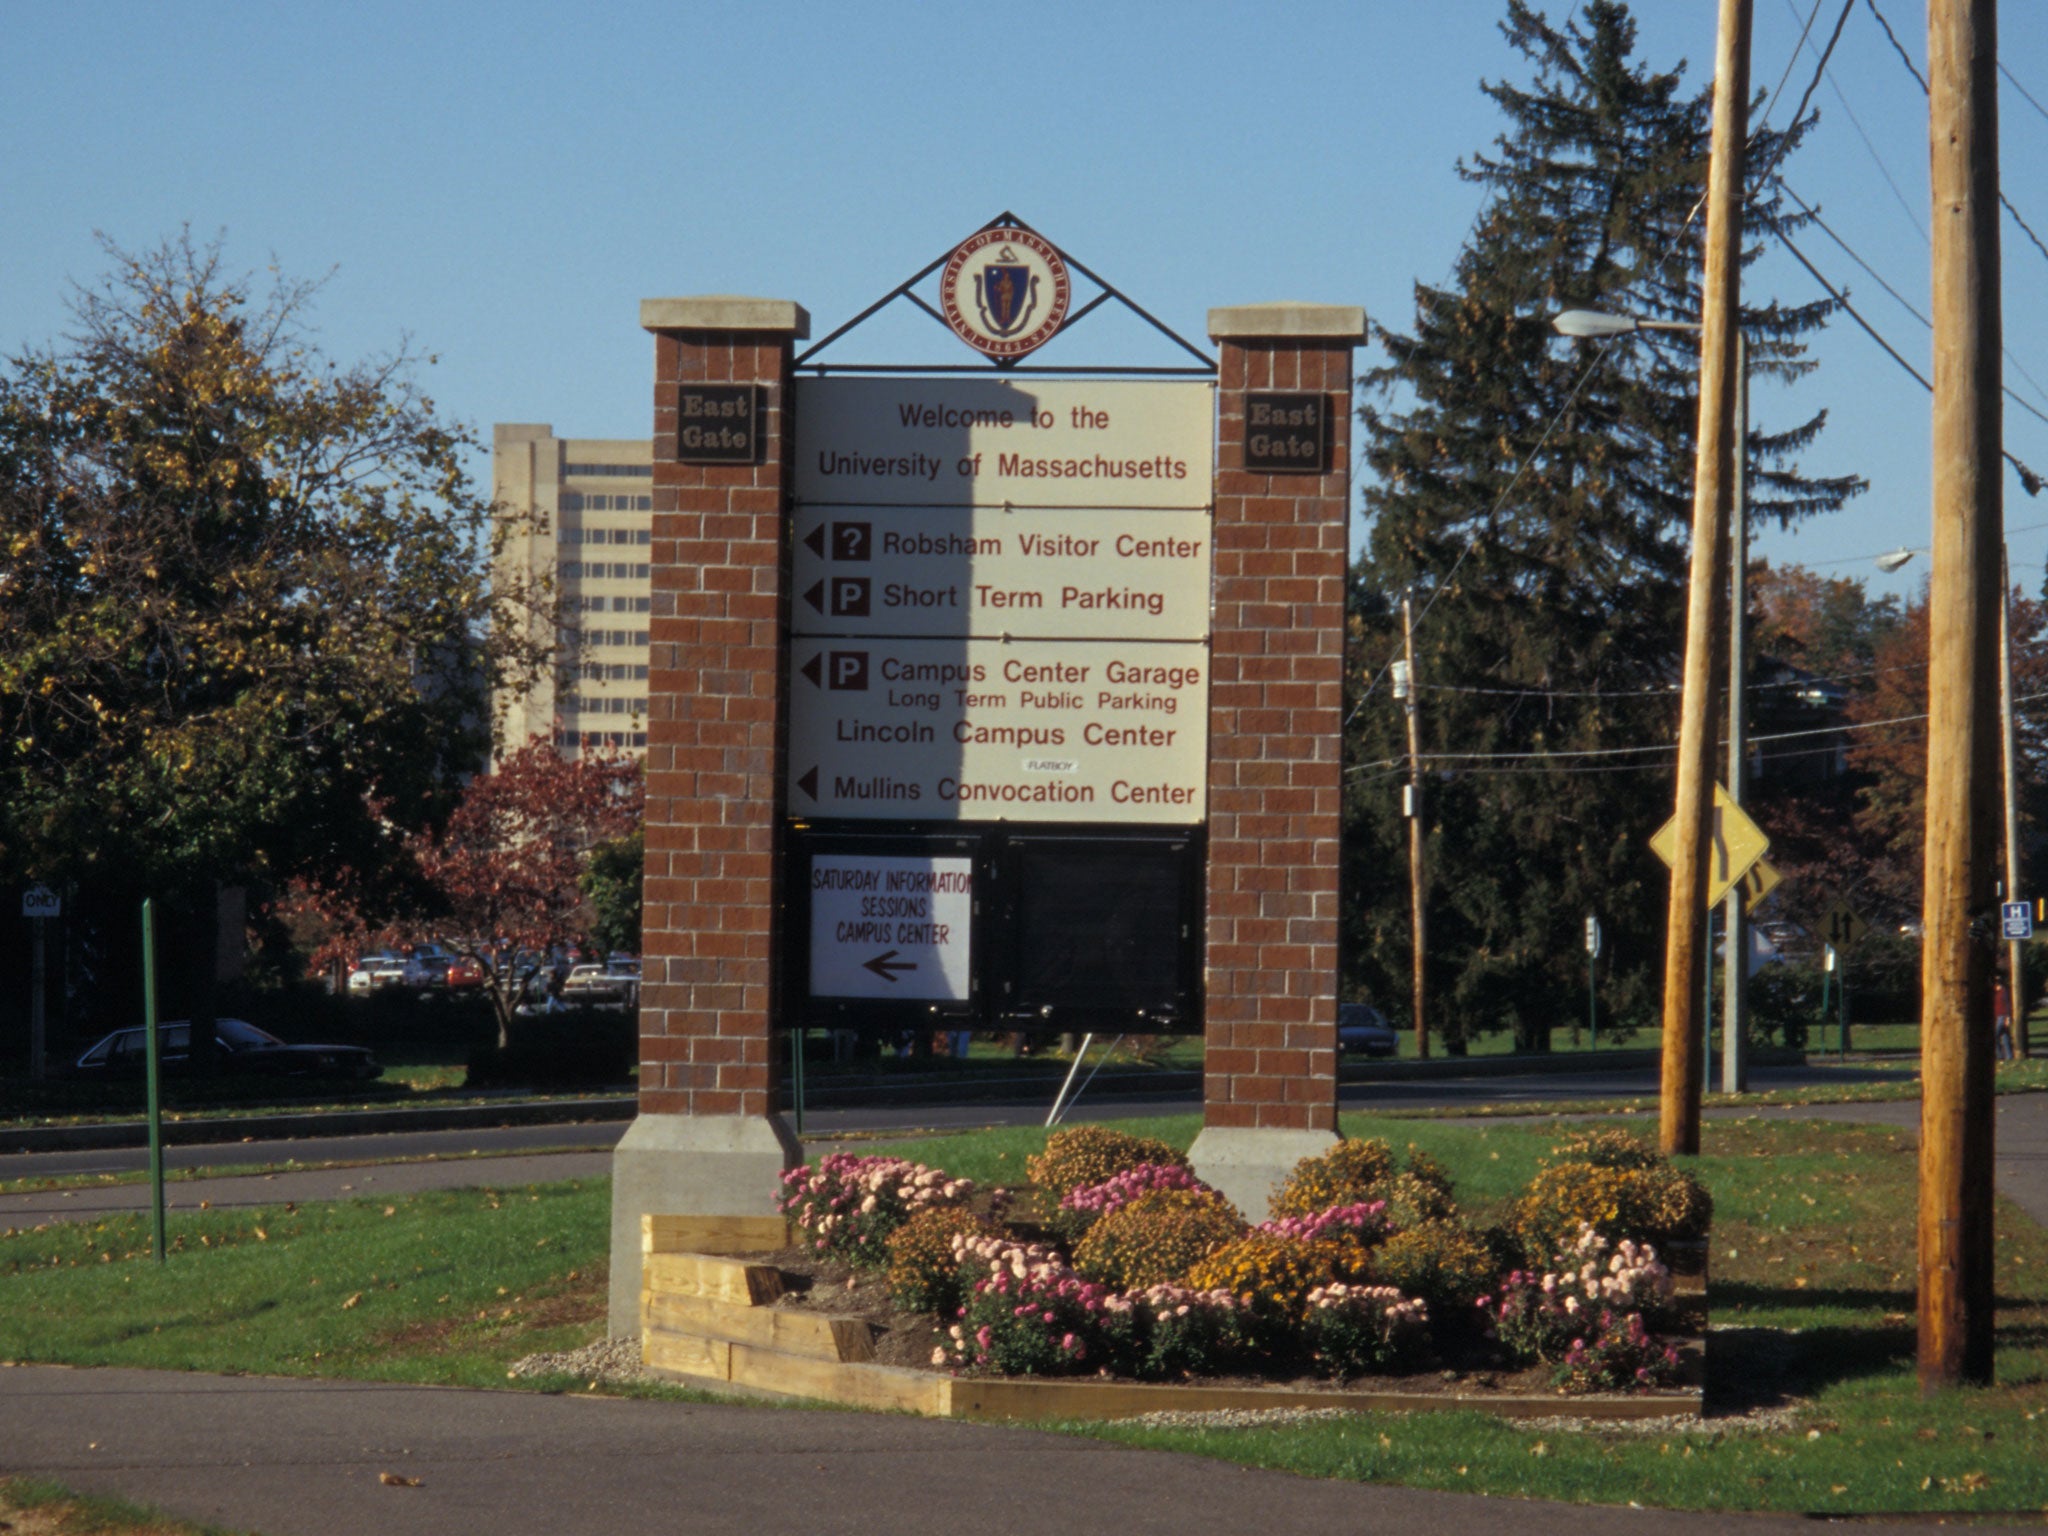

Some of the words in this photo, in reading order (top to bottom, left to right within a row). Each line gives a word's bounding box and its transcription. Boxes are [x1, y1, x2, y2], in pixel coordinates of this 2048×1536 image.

[986, 341, 1022, 351] 1863
[683, 394, 748, 417] East
[899, 404, 1014, 429] Welcome
[1030, 406, 1054, 429] to
[1072, 406, 1110, 429] the
[1250, 403, 1316, 426] East
[683, 425, 747, 448] Gate
[1250, 435, 1315, 457] Gate
[819, 451, 940, 481] University
[957, 453, 982, 477] of
[998, 454, 1187, 479] Massachusetts
[883, 532, 1001, 556] Robsham
[1019, 534, 1100, 557] Visitor
[1115, 534, 1201, 558] Center
[840, 583, 863, 611] P
[884, 584, 957, 607] Short
[976, 585, 1042, 608] Term
[1062, 586, 1164, 615] Parking
[838, 657, 861, 686] P
[881, 658, 986, 686] Campus
[1003, 659, 1090, 684] Center
[1106, 660, 1200, 689] Garage
[888, 689, 940, 710] Long
[955, 690, 1006, 709] Term
[1020, 691, 1083, 710] Public
[1098, 692, 1177, 714] Parking
[837, 719, 935, 743] Lincoln
[953, 720, 1065, 748] Campus
[1083, 723, 1177, 747] Center
[834, 776, 921, 801] Mullins
[937, 777, 1094, 804] Convocation
[1111, 780, 1196, 805] Center
[813, 868, 881, 891] SATURDAY
[861, 896, 926, 918] SESSIONS
[2010, 905, 2021, 919] H
[836, 920, 891, 944] CAMPUS
[898, 922, 949, 945] CENTER
